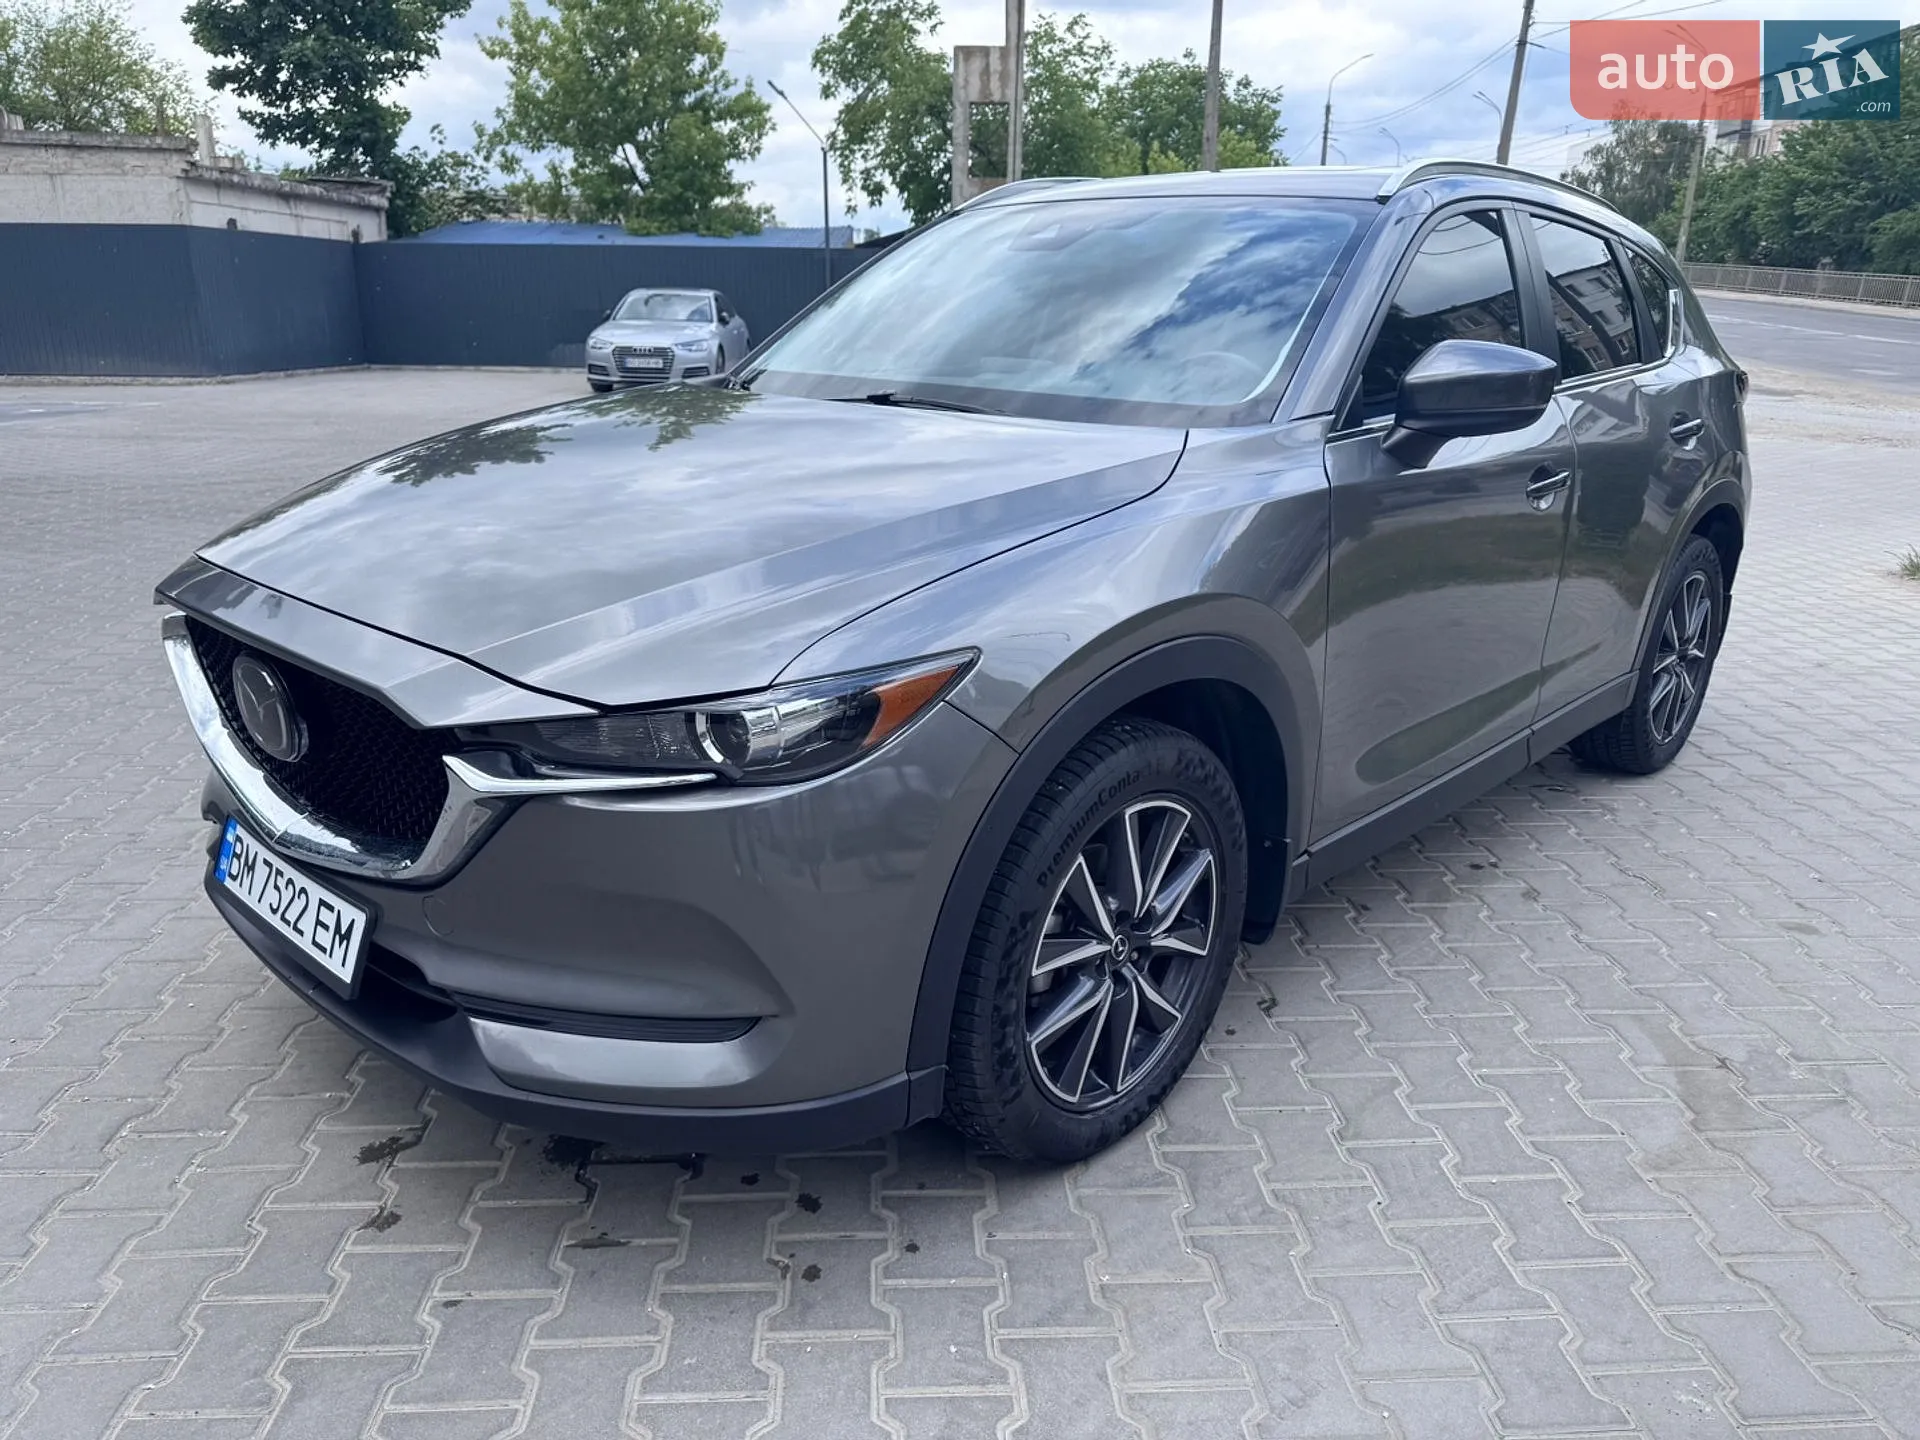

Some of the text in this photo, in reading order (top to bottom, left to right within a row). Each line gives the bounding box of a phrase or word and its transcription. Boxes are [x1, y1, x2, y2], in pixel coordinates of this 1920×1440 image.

[227, 836, 355, 968] BM 7522 EM
